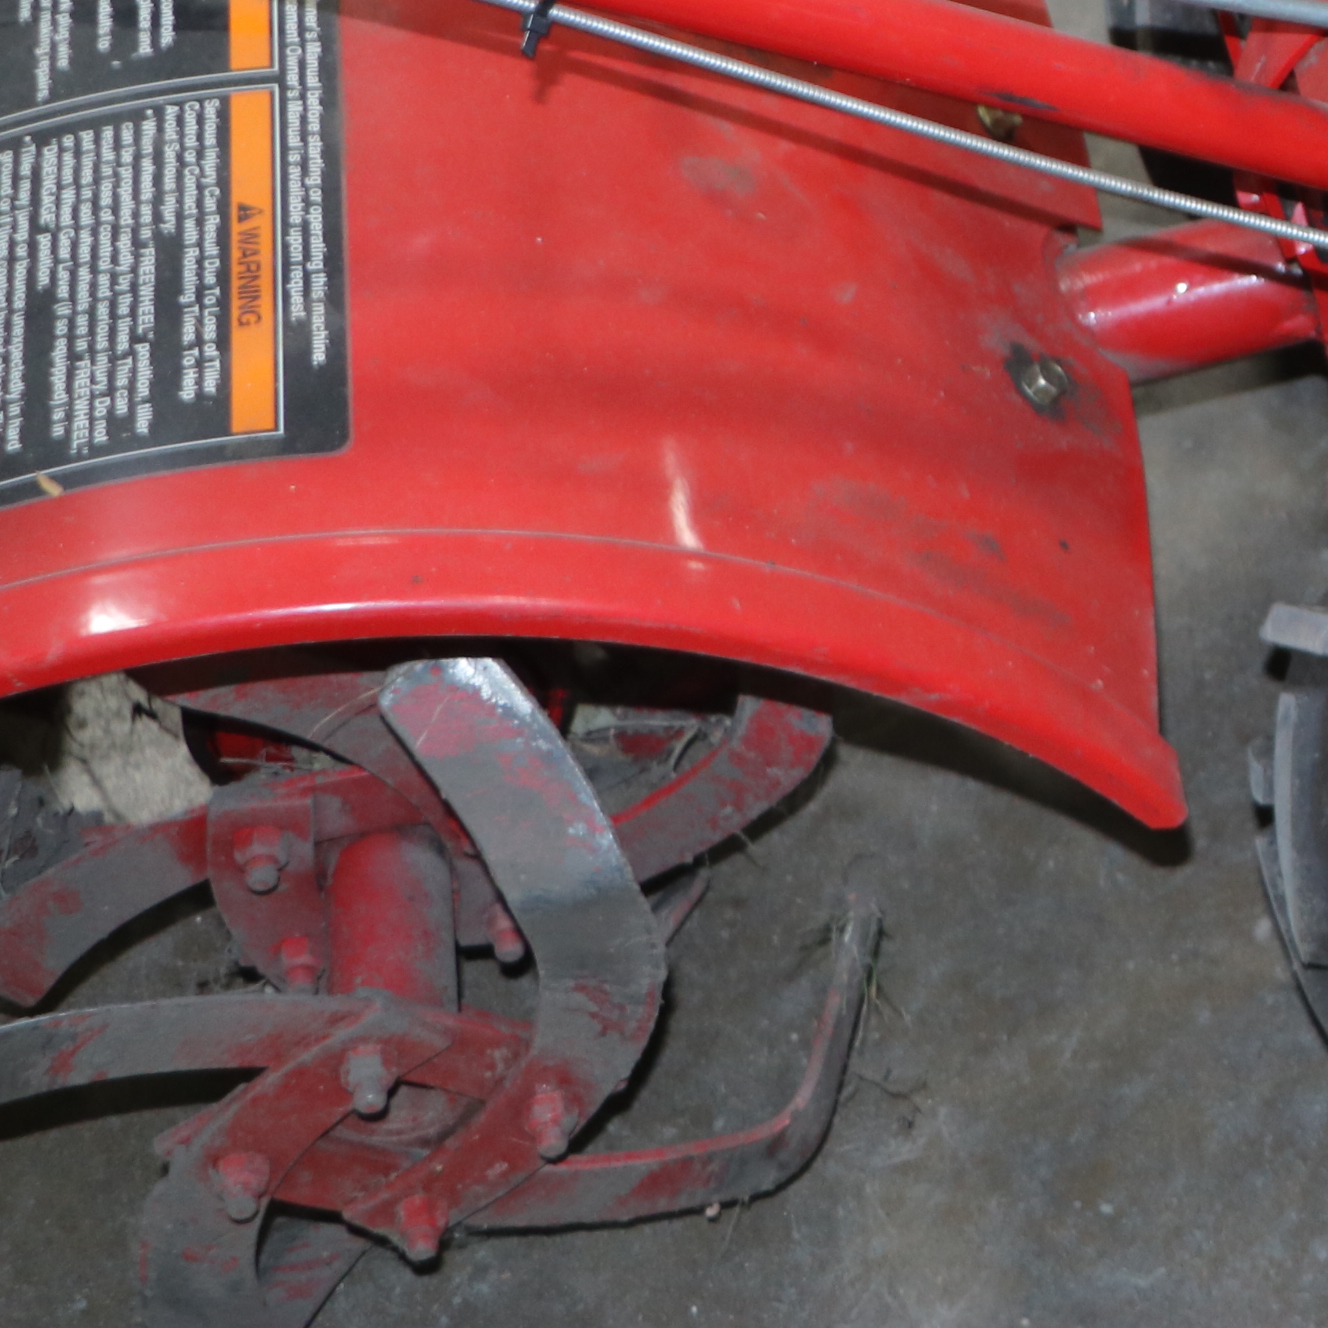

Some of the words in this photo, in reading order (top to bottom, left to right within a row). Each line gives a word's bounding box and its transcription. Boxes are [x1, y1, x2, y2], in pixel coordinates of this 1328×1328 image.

[35, 11, 55, 56] making
[54, 13, 71, 38] plug
[57, 41, 72, 67] wire
[98, 36, 113, 49] to
[139, 31, 153, 52] and
[34, 56, 53, 101] repairs.
[286, 46, 301, 97] Owner's
[306, 42, 322, 87] Manual
[164, 105, 179, 139] Avoid
[184, 101, 200, 146] Control
[204, 98, 220, 145] Serious
[287, 100, 303, 146] Manual
[307, 90, 323, 131] before
[62, 134, 75, 147] or
[78, 130, 95, 150] put
[101, 126, 115, 161] result
[122, 122, 134, 144] can
[141, 118, 157, 154] When
[20, 143, 36, 176] Tiller
[61, 150, 76, 184] when
[81, 153, 96, 184] tines
[101, 164, 115, 176] in
[121, 147, 136, 163] be
[164, 143, 179, 190] Serious
[185, 149, 196, 162] or
[201, 148, 220, 183] Injury
[288, 150, 303, 161] is
[305, 135, 323, 184] starting
[0, 151, 14, 195] ground
[141, 157, 156, 200] wheels
[0, 198, 11, 210] or
[14, 179, 31, 205] may
[60, 186, 76, 225] Wheel
[80, 186, 96, 199] in
[100, 179, 114, 205] loss
[116, 166, 136, 224] propelled
[185, 166, 199, 215] Contact
[204, 187, 220, 211] Can
[288, 165, 304, 223] available
[308, 188, 318, 201] or
[15, 208, 33, 240] jump
[80, 202, 95, 225] soil
[99, 208, 114, 222] of
[140, 203, 153, 223] are
[160, 193, 177, 235] Injury:
[59, 228, 75, 259] Gear
[78, 227, 93, 262] when
[140, 226, 155, 238] in
[184, 217, 199, 244] with
[204, 215, 220, 254] Result
[285, 228, 303, 261] upon
[306, 205, 326, 269] operating
[17, 243, 28, 256] or
[36, 233, 53, 290] position.
[98, 225, 114, 270] control
[115, 228, 135, 272] rapidly
[14, 259, 30, 308] bounce
[57, 262, 73, 298] Lever
[98, 273, 113, 297] and
[115, 275, 132, 291] by
[179, 248, 199, 302] Rotating
[205, 258, 220, 283] Due
[237, 227, 262, 326] WARNING
[312, 273, 327, 298] this
[76, 265, 93, 310] wheels
[205, 287, 220, 304] To
[286, 265, 305, 321] request.
[54, 301, 72, 315] (if
[117, 293, 133, 315] the
[55, 318, 68, 335] so
[76, 314, 89, 335] are
[96, 300, 113, 349] serious
[116, 318, 133, 354] tines.
[183, 304, 199, 345] Tines.
[204, 308, 220, 339] Loss
[311, 303, 328, 365] machine.
[5, 312, 25, 399] unexpectedly
[75, 337, 91, 351] in
[183, 347, 199, 365] To
[204, 343, 220, 355] of
[49, 338, 69, 405] equipped)
[91, 352, 112, 395] injury.
[116, 356, 132, 386] This
[134, 343, 153, 401] position,
[179, 369, 198, 400] Help
[205, 359, 220, 393] Tiller
[9, 401, 24, 416] in
[53, 406, 68, 419] is
[94, 396, 110, 417] Do
[115, 390, 130, 414] can
[53, 422, 68, 436] in
[93, 420, 109, 444] not
[136, 403, 153, 434] tiller
[8, 418, 23, 451] hard
